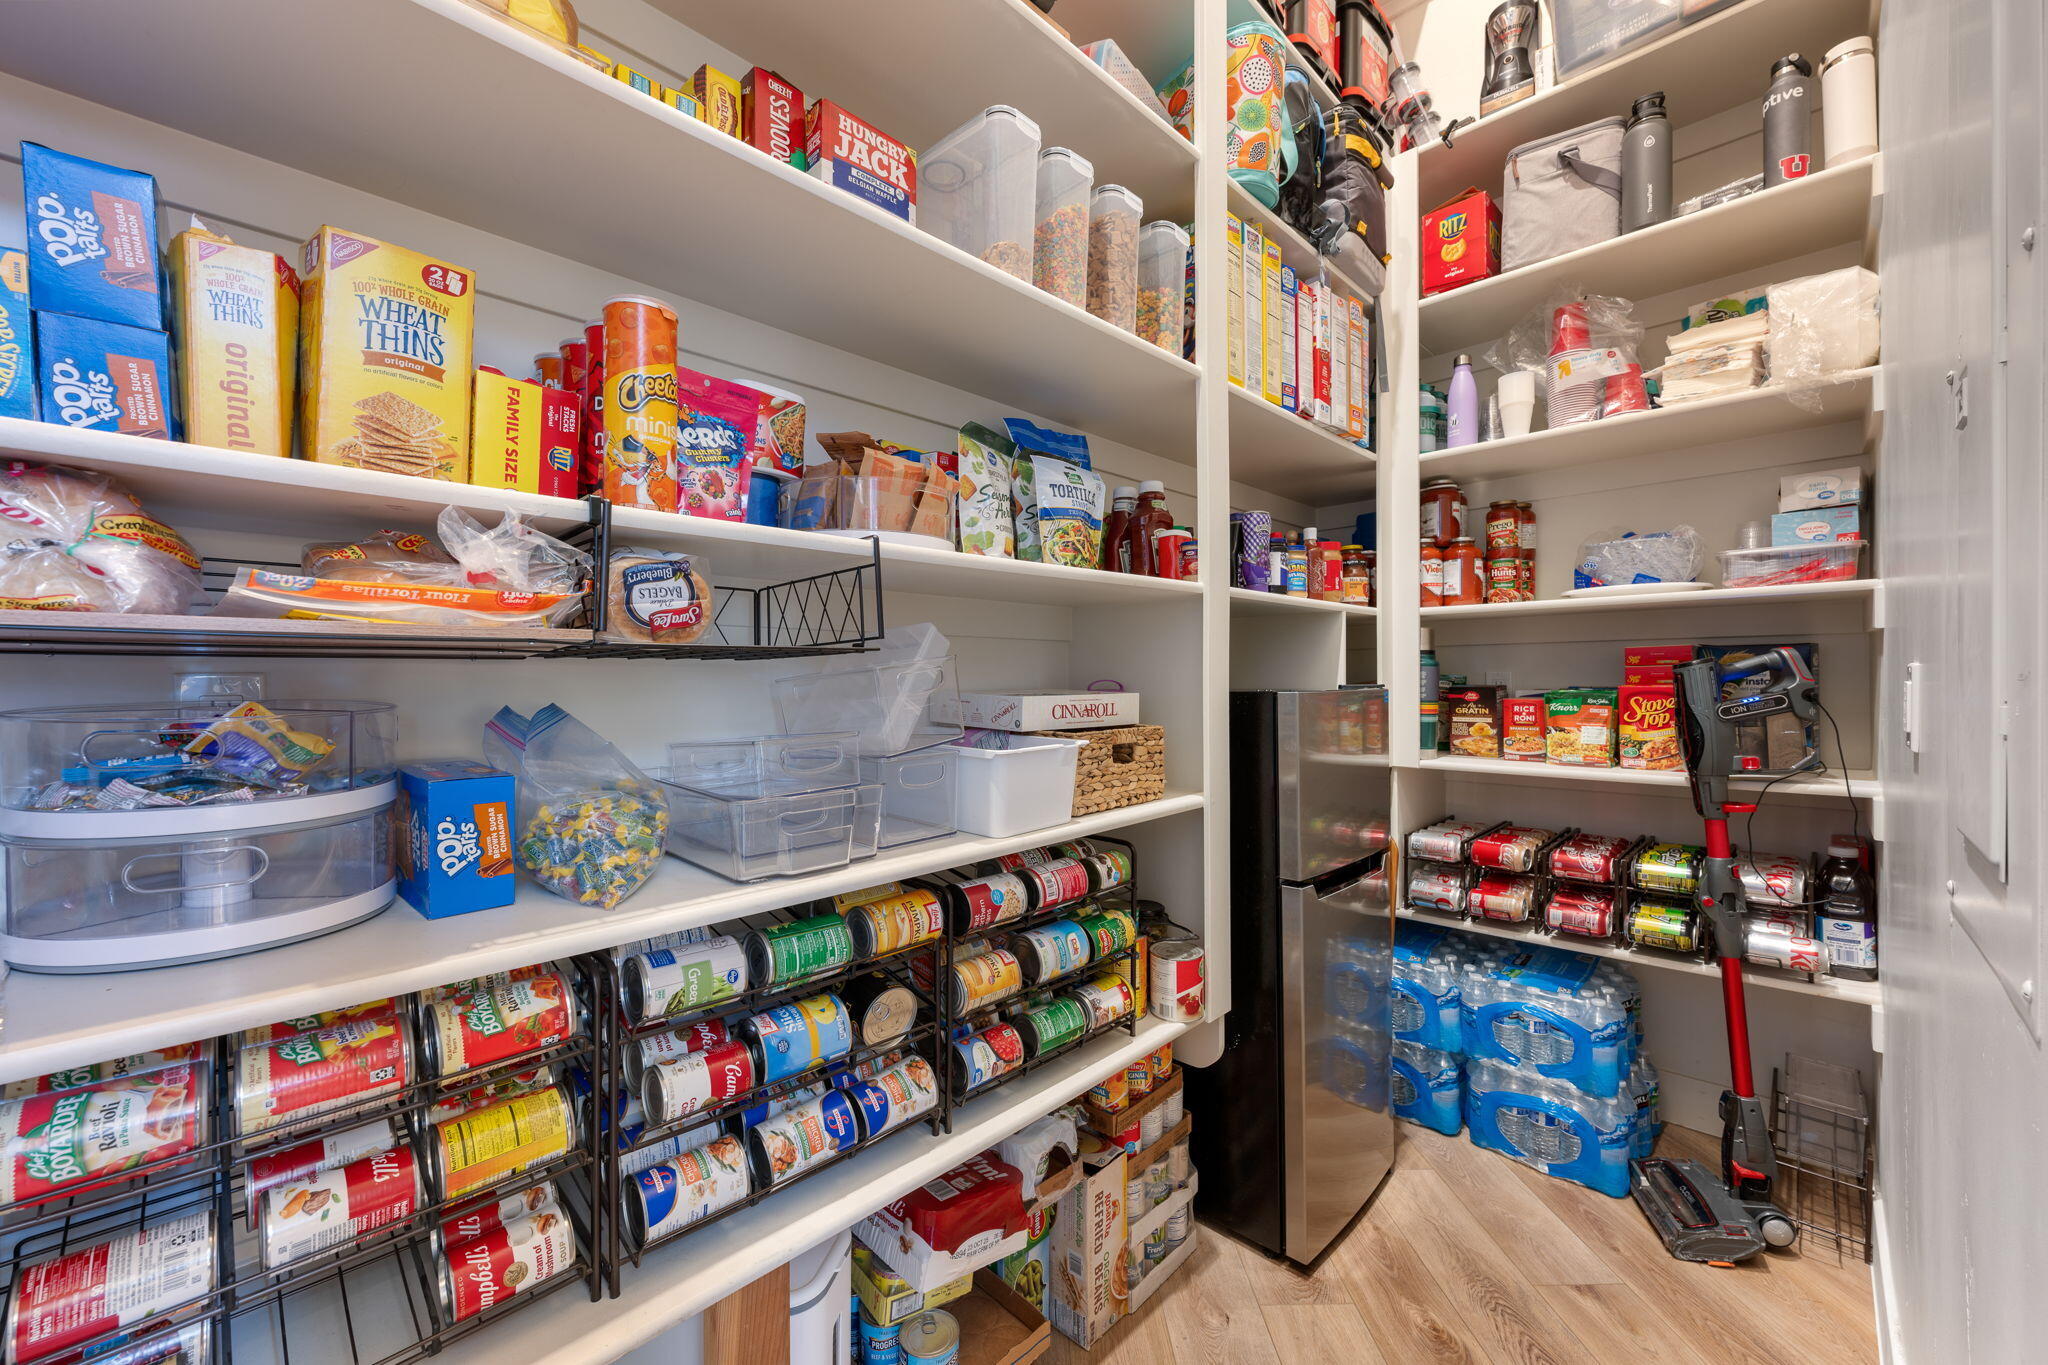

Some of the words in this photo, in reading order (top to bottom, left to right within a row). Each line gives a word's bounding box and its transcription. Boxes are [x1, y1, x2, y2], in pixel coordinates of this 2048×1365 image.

[768, 78, 792, 99] CHEEZ-IT
[839, 113, 907, 164] HUNGRY
[835, 130, 910, 192] JACK
[1779, 154, 1810, 180] U
[848, 176, 874, 192] BELGIAN
[875, 188, 897, 204] WAFFLE
[855, 170, 893, 194] COMPLETE
[114, 202, 128, 233] SUGAR
[1440, 212, 1467, 237] RITZ
[128, 214, 145, 264] CINNAMON
[429, 266, 443, 281] 2
[206, 289, 263, 312] WHEAT
[352, 281, 376, 293] 100%
[379, 284, 415, 302] WHOLE
[418, 293, 450, 317] GRAIN
[355, 294, 446, 337] WHEAT
[129, 362, 142, 391] SUGAR
[384, 356, 425, 372] original
[143, 373, 158, 420] CINNAMON
[219, 342, 255, 449] original
[134, 394, 148, 425] BROWN
[505, 387, 520, 445] FAMILY
[504, 446, 518, 483] SIZE
[553, 446, 572, 472] RITZ
[1049, 484, 1096, 507] TORTILLA
[1488, 521, 1512, 532] Prego
[627, 567, 673, 583] Blueberry
[342, 584, 421, 600] Tortillas
[423, 593, 471, 604] Flour
[640, 587, 682, 599] BAGELS
[991, 702, 1017, 724] CINNAROLL
[1052, 703, 1117, 721] CINNAROLL
[1550, 702, 1579, 712] Knorr
[1624, 697, 1676, 722] Stove
[1731, 706, 1747, 714] ION
[1641, 712, 1670, 729] Top
[488, 808, 496, 831] SUGAR
[497, 813, 507, 852] CINNAMON
[688, 967, 701, 1006] Green
[468, 1009, 483, 1030] Chef
[89, 1118, 102, 1142] Beef
[99, 1101, 120, 1152] Ravioli
[808, 1118, 822, 1151] CHICKEN
[832, 1110, 846, 1135] SWANSON
[50, 1091, 88, 1184] BOYARDEE
[29, 1151, 49, 1178] Chef
[1094, 1191, 1104, 1255] REFRIED
[559, 1241, 568, 1263] SOUP
[1094, 1264, 1104, 1315] BEANS
[1102, 1251, 1111, 1308] ORGANIC
[28, 1307, 42, 1343] Nutrition
[41, 1316, 53, 1339] Facts
